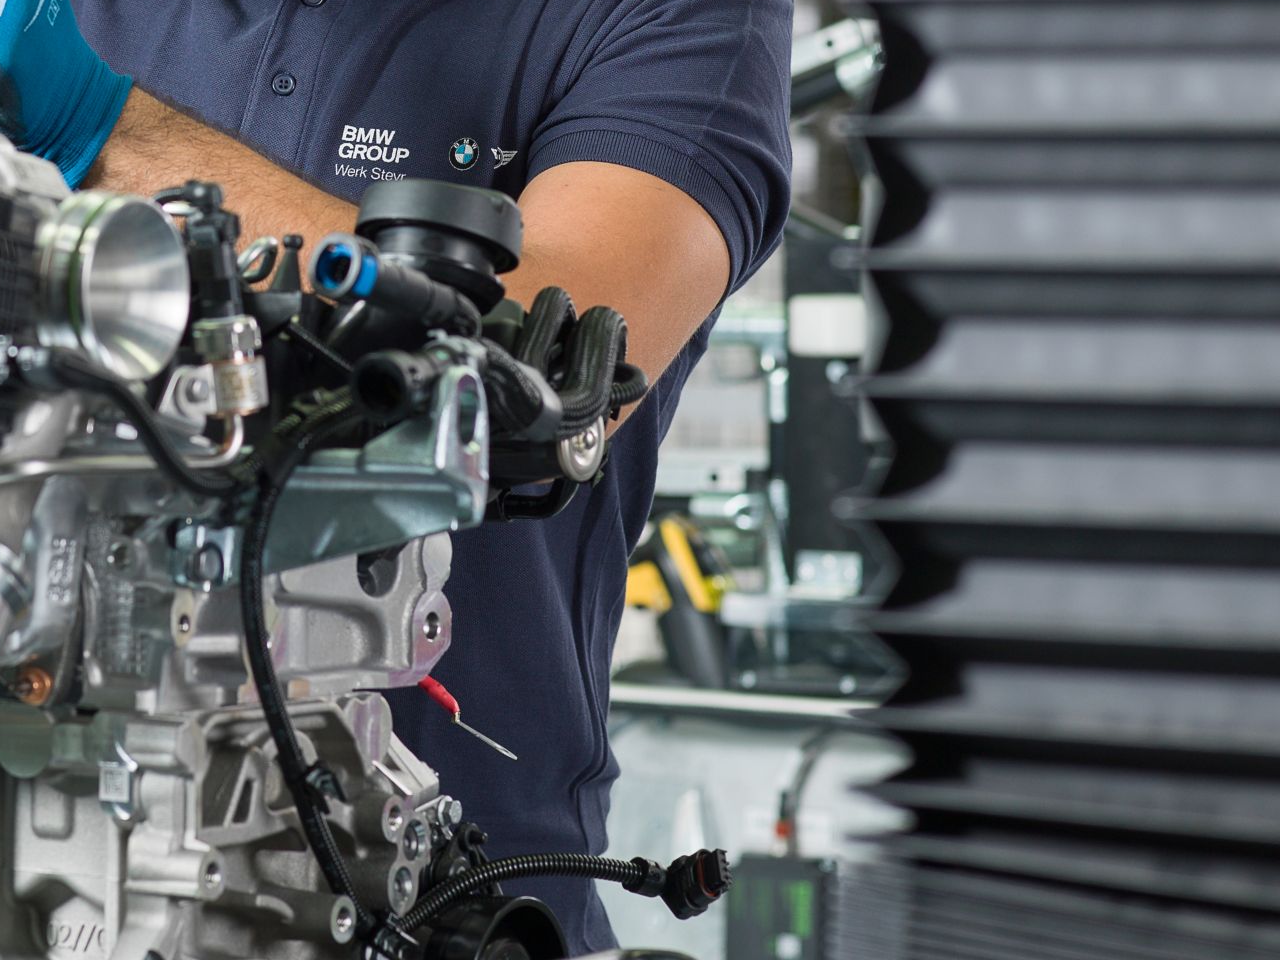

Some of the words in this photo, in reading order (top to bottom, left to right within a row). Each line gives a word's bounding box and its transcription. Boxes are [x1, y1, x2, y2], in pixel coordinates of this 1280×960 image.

[341, 124, 396, 145] BMW
[338, 142, 410, 163] GROUP
[334, 163, 368, 178] Werk
